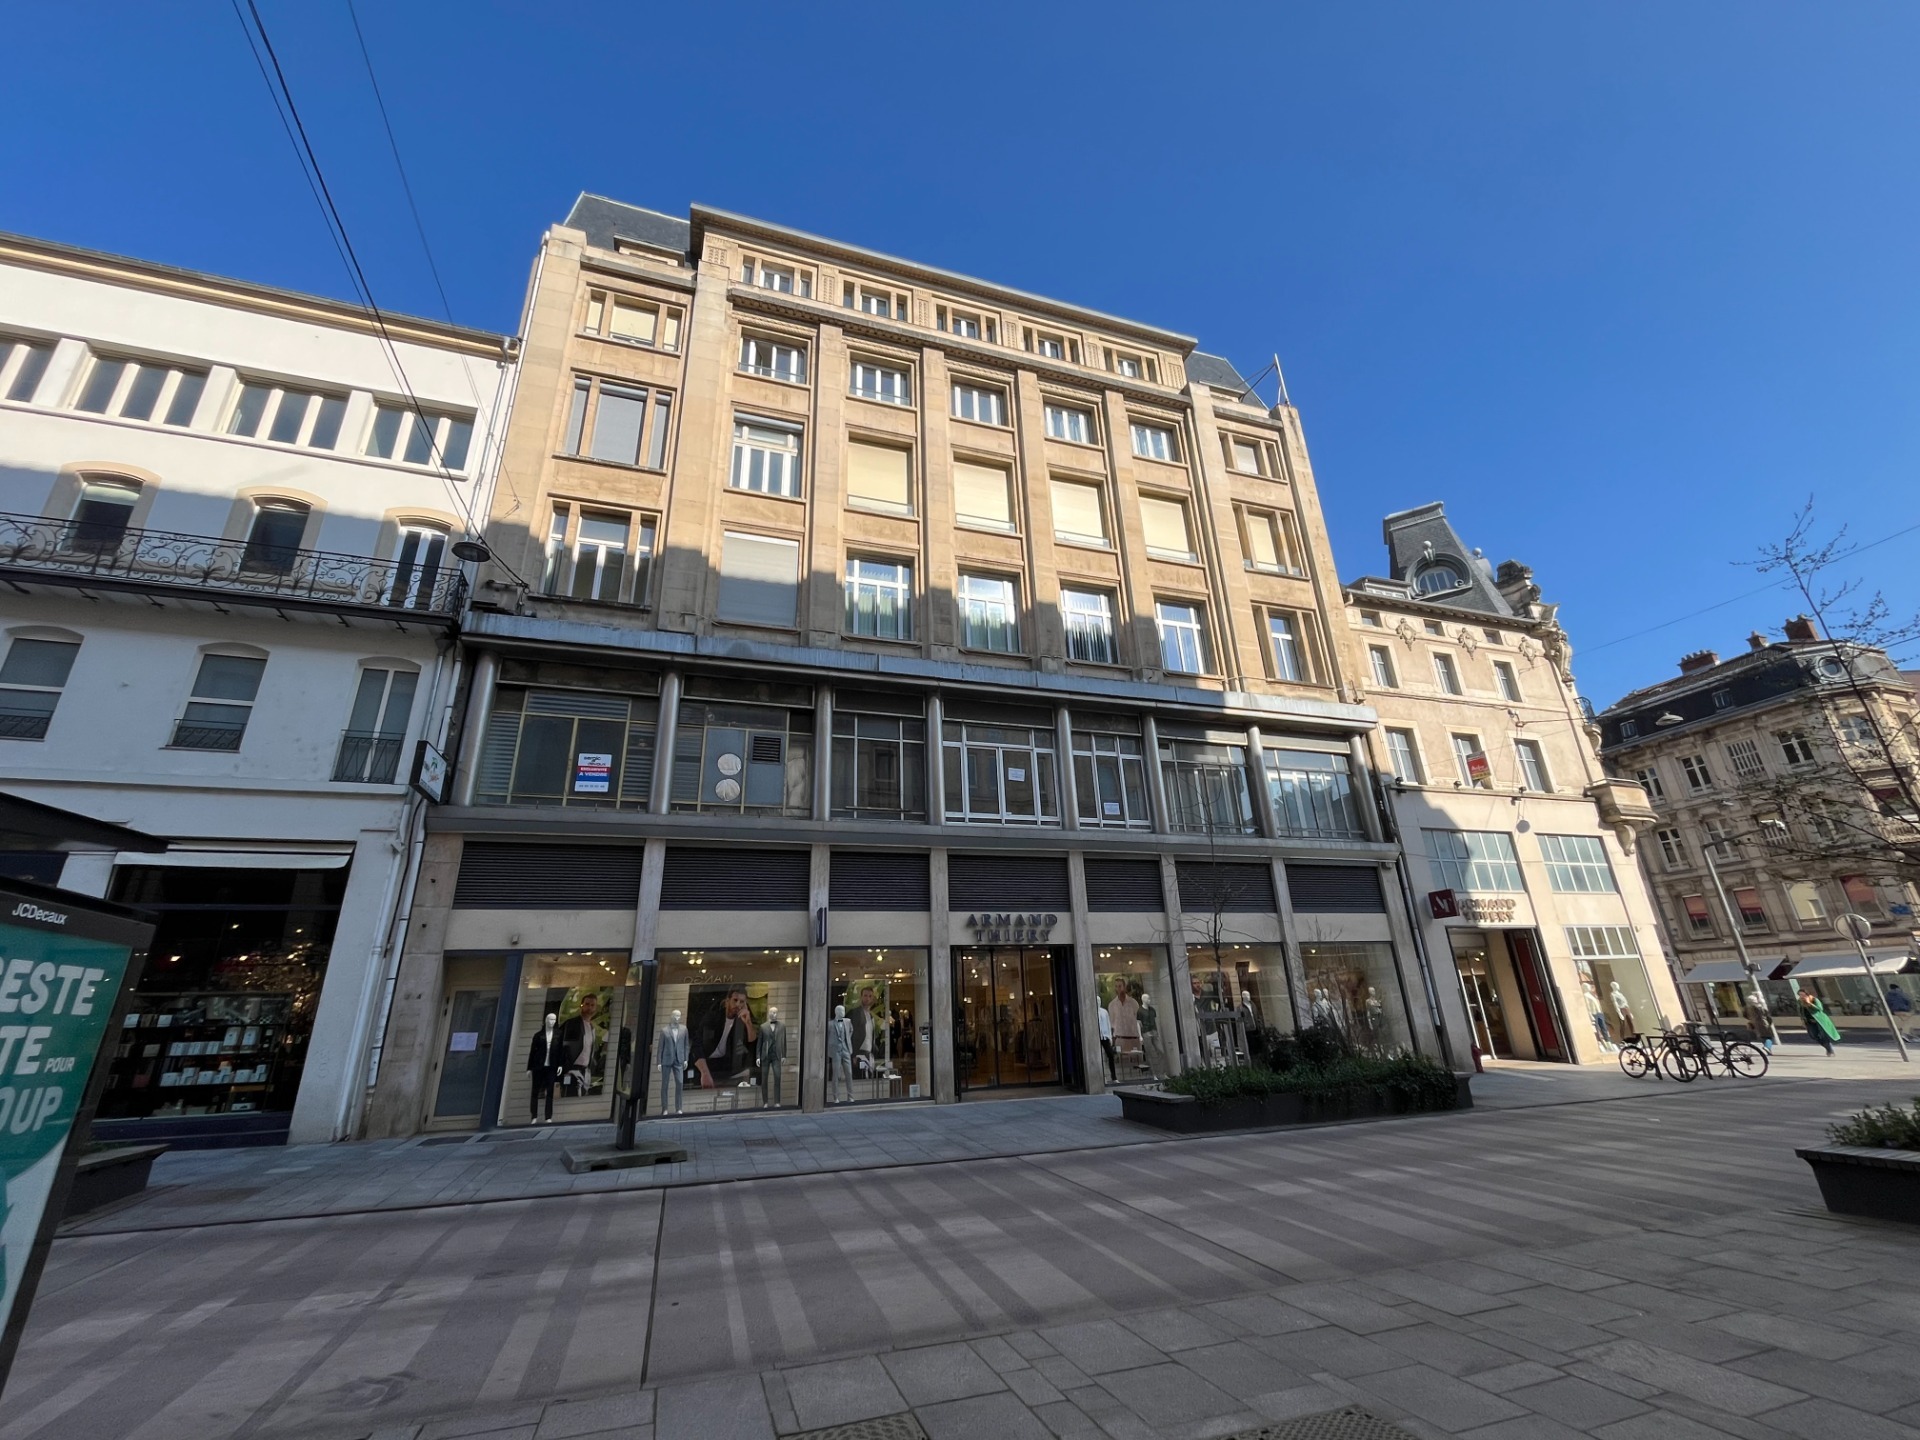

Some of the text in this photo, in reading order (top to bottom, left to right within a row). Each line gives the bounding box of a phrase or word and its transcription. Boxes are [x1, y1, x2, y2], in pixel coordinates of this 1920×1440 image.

[12, 903, 68, 925] JCDecaux
[965, 913, 1058, 927] ARMAND
[975, 928, 1052, 942] THIERY
[0, 956, 105, 1016] ESTE
[44, 1057, 76, 1073] POUR
